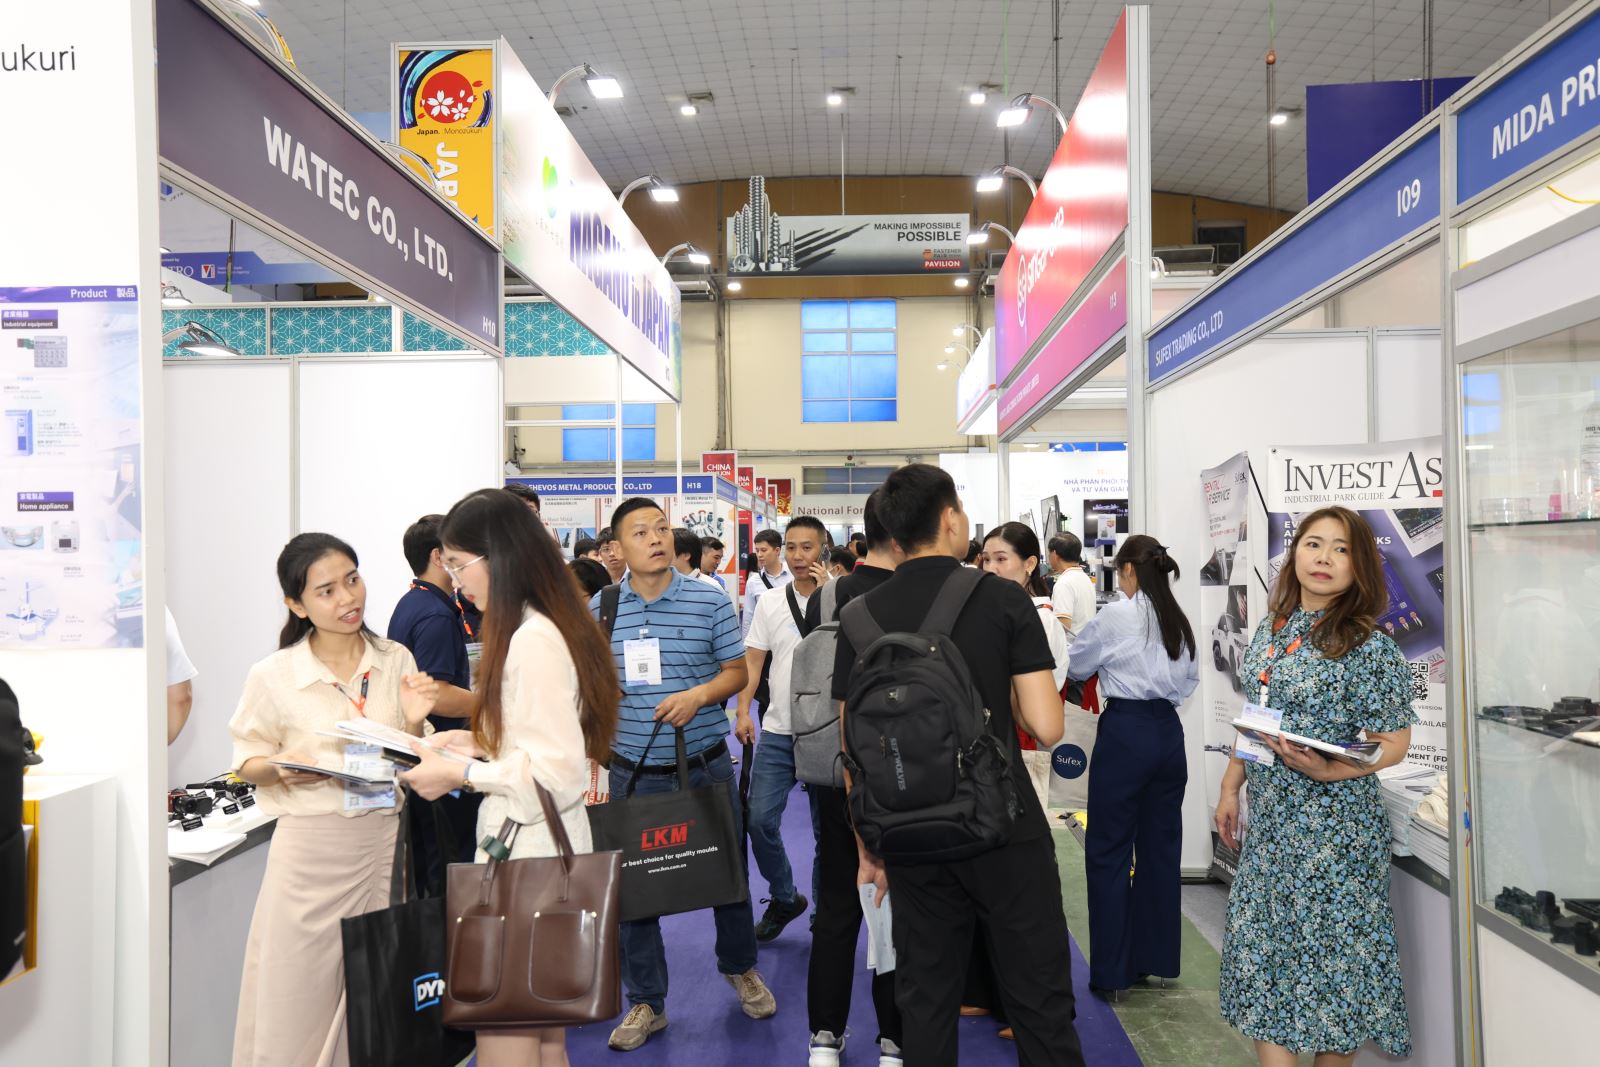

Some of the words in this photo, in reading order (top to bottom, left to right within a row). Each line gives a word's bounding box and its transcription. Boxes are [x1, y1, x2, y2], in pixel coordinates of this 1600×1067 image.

[1, 44, 76, 72] ukuri
[1492, 92, 1555, 160] MIDA
[1561, 57, 1600, 117] PR
[416, 128, 440, 136] Japan.
[436, 142, 458, 210] JAP
[263, 116, 360, 221] WATEC
[366, 196, 408, 262] CO.,
[414, 227, 454, 282] LTD.
[1396, 178, 1421, 217] I09
[898, 231, 962, 242] POSSIBLE
[70, 288, 108, 298] Product
[482, 316, 496, 338] H10
[642, 273, 670, 359] JAPAN
[1156, 342, 1172, 367] SUFEX
[1172, 326, 1197, 356] TRADING
[1210, 310, 1223, 334] LTD
[1284, 458, 1392, 492] INVEST
[39, 503, 69, 511] appliance
[1284, 494, 1331, 504] INDUSTRIAL
[1334, 494, 1356, 502] PARK
[1358, 492, 1384, 500] GUIDE
[798, 506, 844, 515] National
[1056, 754, 1082, 766] Sufex
[1408, 752, 1430, 760] MENT
[641, 825, 688, 850] LKM
[644, 855, 664, 864] choice
[675, 850, 696, 859] quality
[696, 846, 718, 855] moulds
